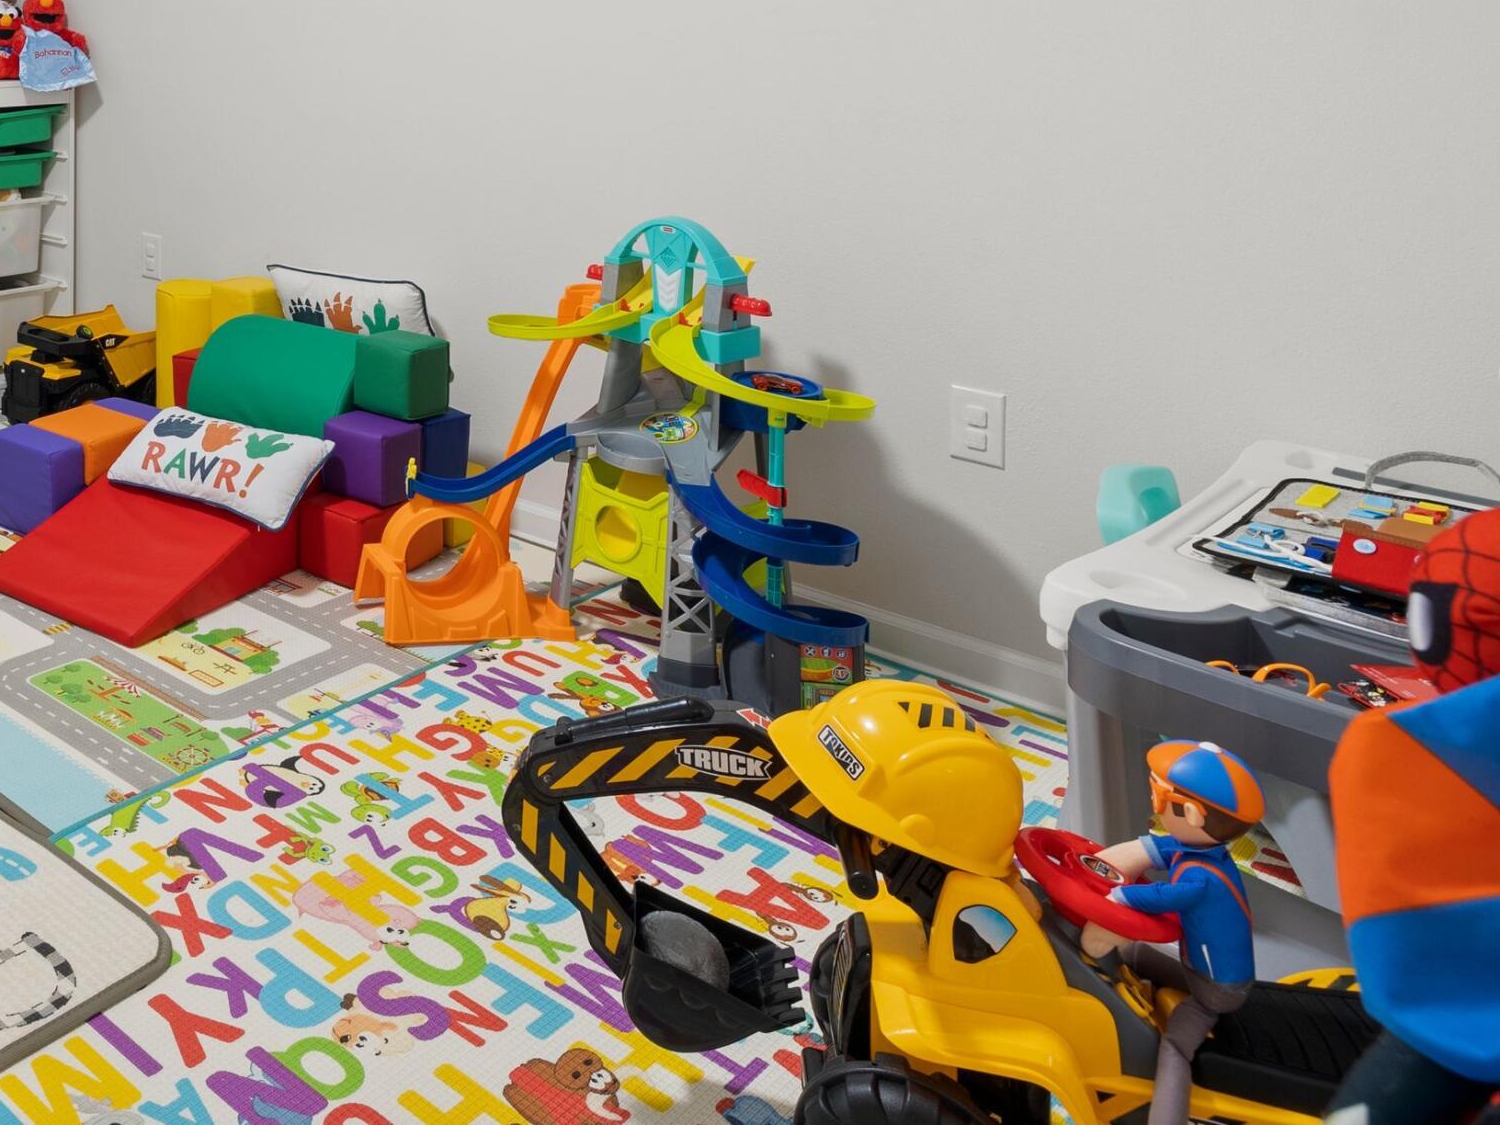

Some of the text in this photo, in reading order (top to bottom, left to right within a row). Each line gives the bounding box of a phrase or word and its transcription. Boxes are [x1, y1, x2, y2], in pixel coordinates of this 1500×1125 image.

[140, 441, 265, 499] RAWR!
[348, 733, 435, 773] H
[679, 748, 765, 777] TRUCK
[417, 771, 487, 812] Y
[408, 817, 487, 866] B
[150, 893, 233, 958] X
[206, 880, 292, 941] D
[293, 928, 371, 984] T
[255, 947, 344, 1029] P
[356, 970, 452, 1041] S
[147, 993, 245, 1068] Y
